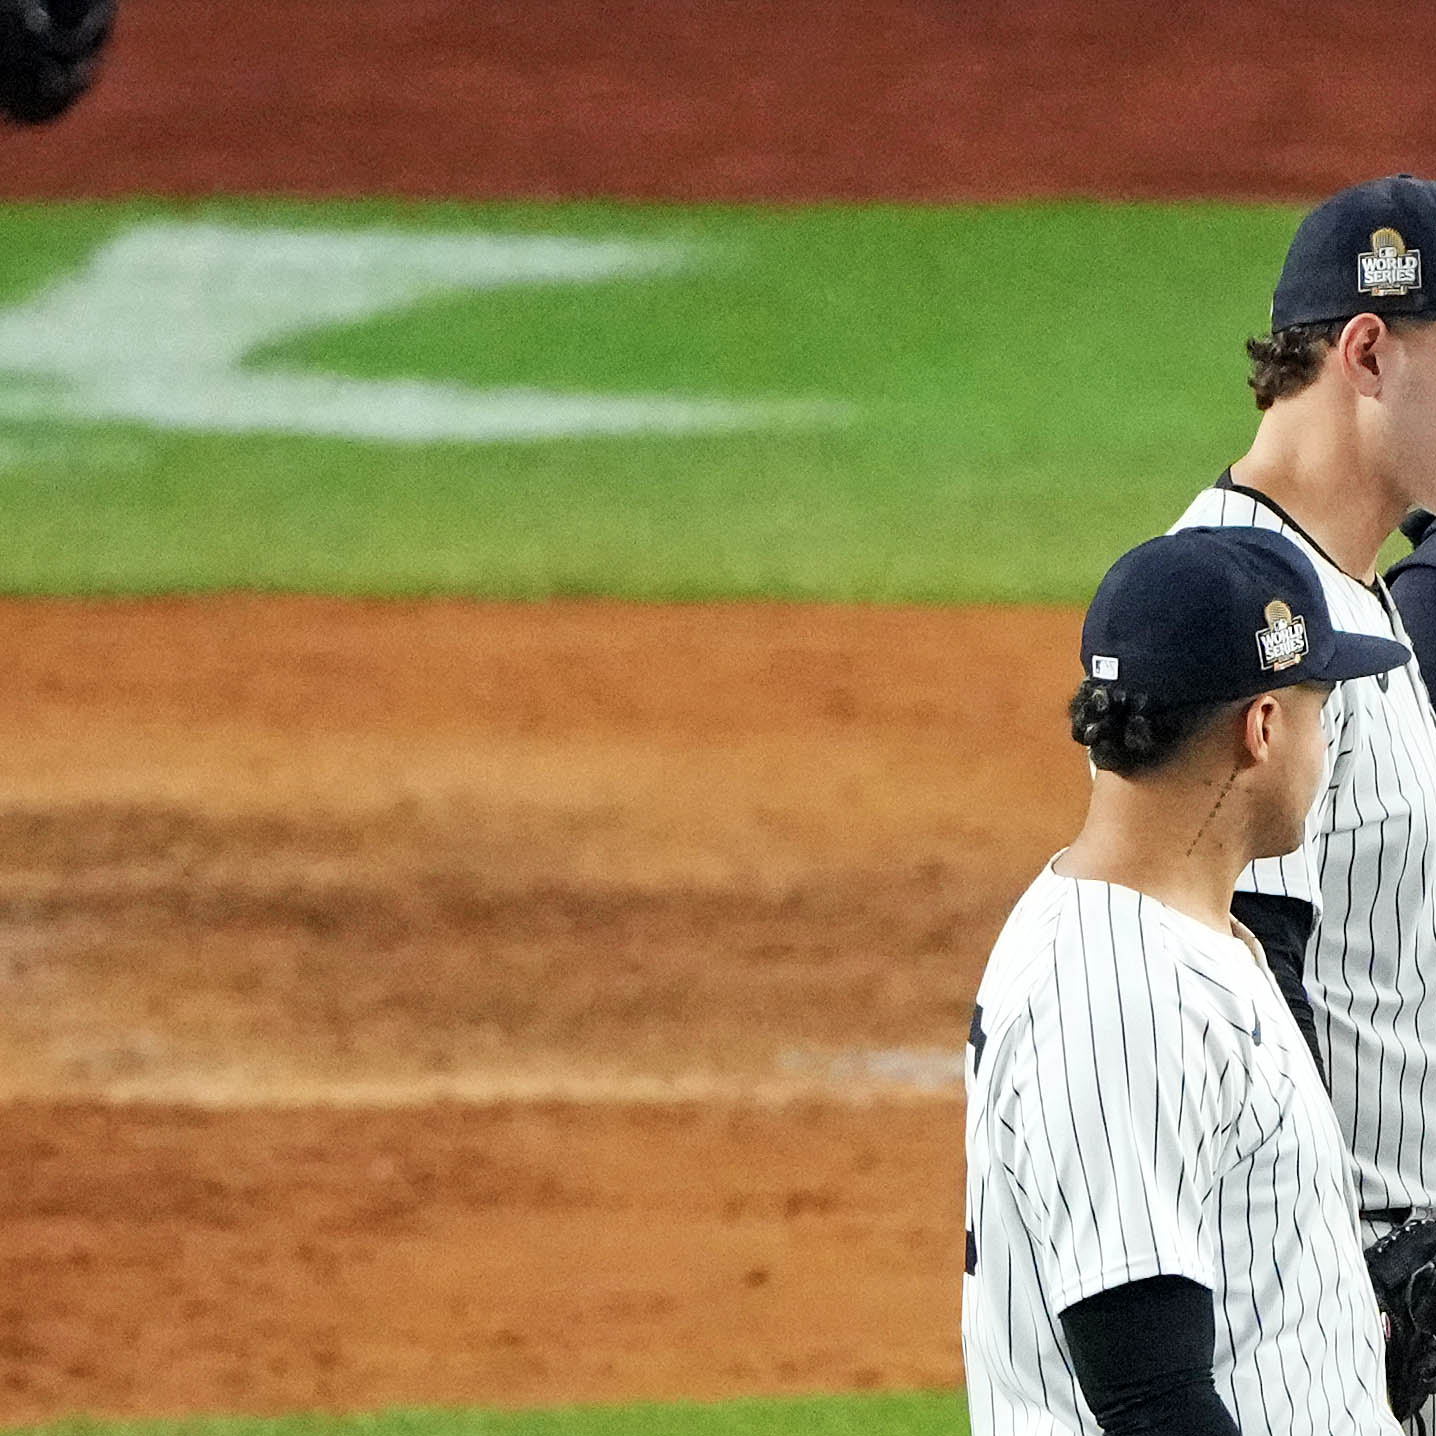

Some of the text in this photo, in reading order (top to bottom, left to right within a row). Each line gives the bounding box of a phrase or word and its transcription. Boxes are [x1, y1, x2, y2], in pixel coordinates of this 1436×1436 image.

[1361, 256, 1418, 271] WORLD
[1364, 269, 1416, 284] SERIES
[1260, 622, 1304, 650] WORLD
[1264, 640, 1305, 661] SERIES
